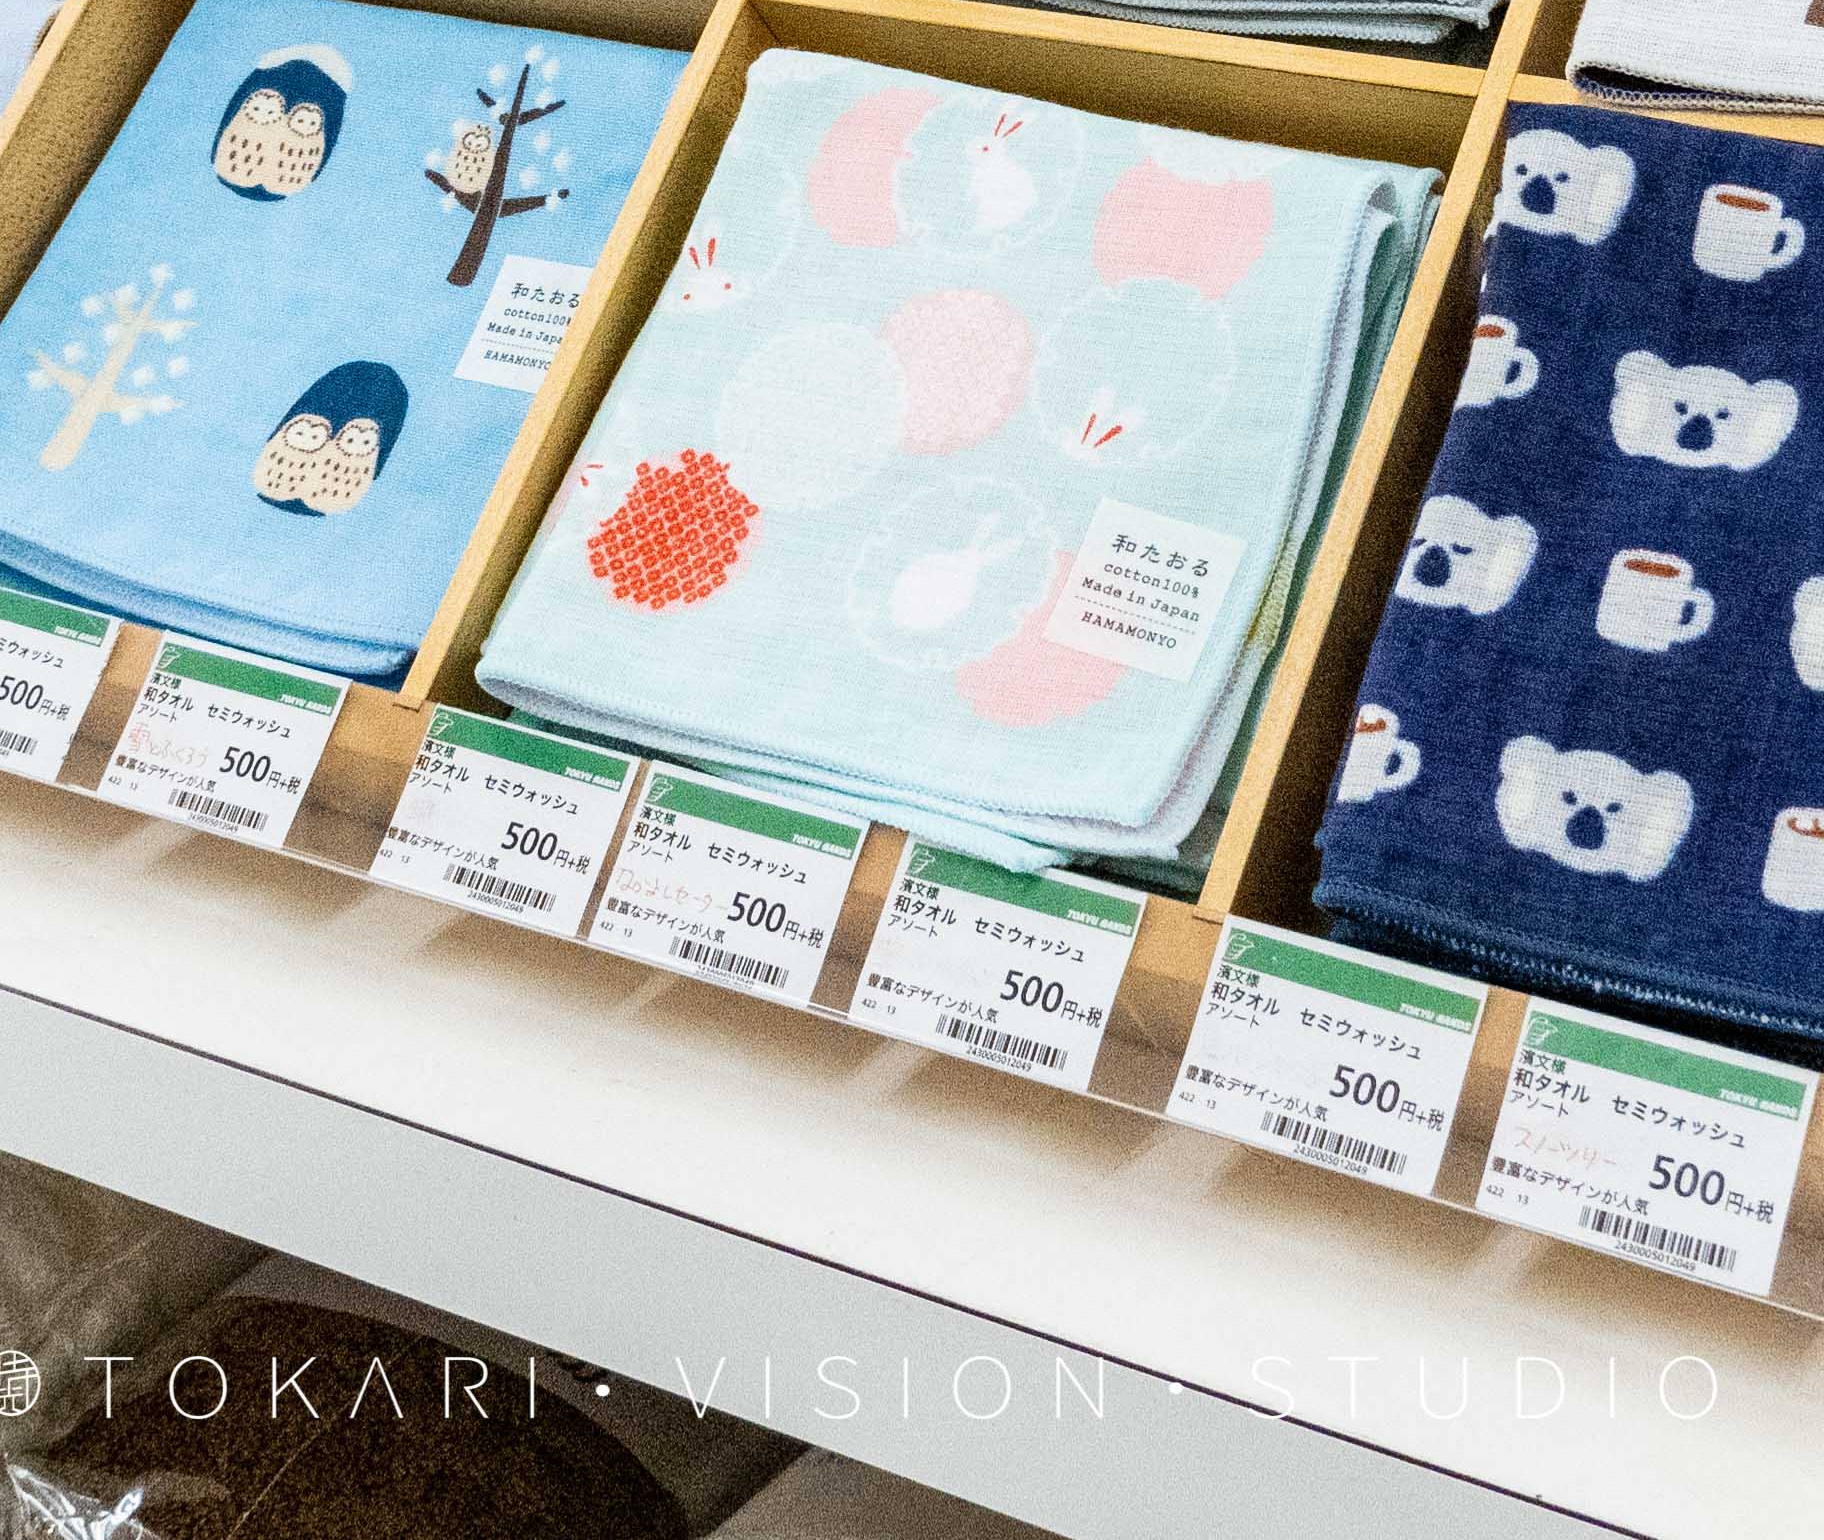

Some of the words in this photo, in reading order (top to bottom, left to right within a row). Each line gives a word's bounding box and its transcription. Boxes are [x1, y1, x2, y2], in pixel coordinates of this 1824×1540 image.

[511, 282, 580, 308] 和たおる
[487, 322, 516, 336] Made
[519, 327, 532, 339] in
[536, 331, 562, 345] Japa
[1112, 534, 1209, 576] 和たおる
[1082, 577, 1122, 597] Made
[1127, 591, 1145, 605] in
[1150, 598, 1200, 622] Japan
[1104, 562, 1199, 598] cotton100%
[1081, 611, 1176, 649] HAMAMONYO
[143, 686, 193, 711] 和タオル
[207, 703, 290, 738] セミウォッシュ
[415, 754, 469, 781] 和タオル
[484, 774, 577, 814] セミウォッシュ
[627, 839, 672, 862] アソート
[633, 821, 691, 850] 和タオル
[707, 842, 806, 884] セミウォッシュ
[606, 896, 725, 944] 豊富なデザインが人気
[726, 891, 823, 948] 500円+税
[887, 913, 937, 937] アソート
[893, 894, 956, 924] 和タオル
[974, 917, 1083, 962] セミウォッシュ
[866, 972, 998, 1023] 豊富なデザインが人気
[999, 969, 1102, 1028] 500円+税
[1205, 1001, 1259, 1028] アソート
[1210, 981, 1279, 1015] 和タオル
[1300, 1007, 1420, 1059] セミウォッシュ
[965, 1043, 1033, 1072] 2430005012049
[1185, 1064, 1327, 1122] 豊富なデザインが人気
[1329, 1064, 1444, 1131] 500円+税
[1509, 1089, 1568, 1117] アソート
[1513, 1067, 1589, 1103] 和タオル
[1612, 1095, 1744, 1148] セミウォッシュ
[1293, 1143, 1367, 1174] 2430005012049
[1492, 1156, 1648, 1215] 豊富なデザインが人気
[1648, 1154, 1773, 1223] 500円+税
